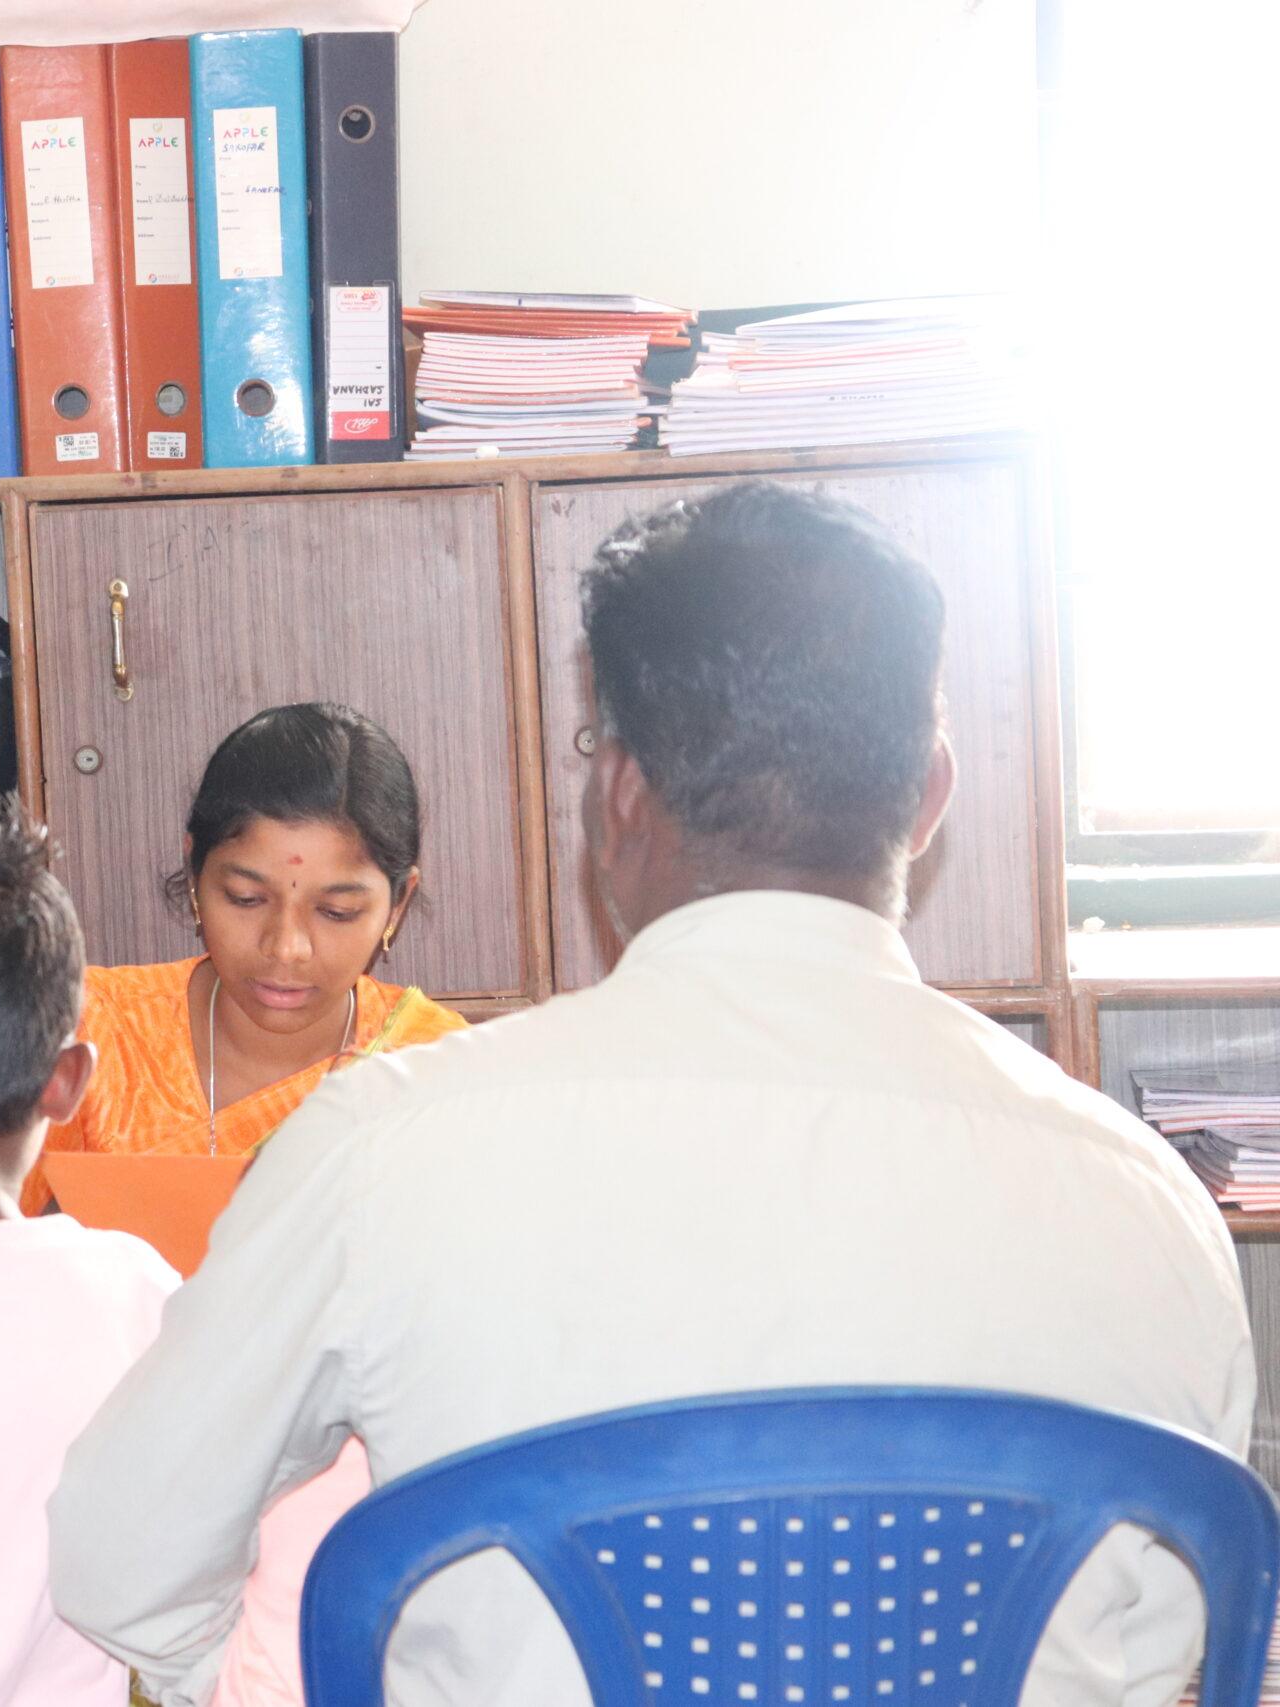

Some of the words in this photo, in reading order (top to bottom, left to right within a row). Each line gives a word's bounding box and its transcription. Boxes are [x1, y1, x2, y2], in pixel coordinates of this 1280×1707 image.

[223, 126, 269, 138] APPLE
[31, 137, 77, 150] APPLE
[138, 137, 178, 149] APPLE
